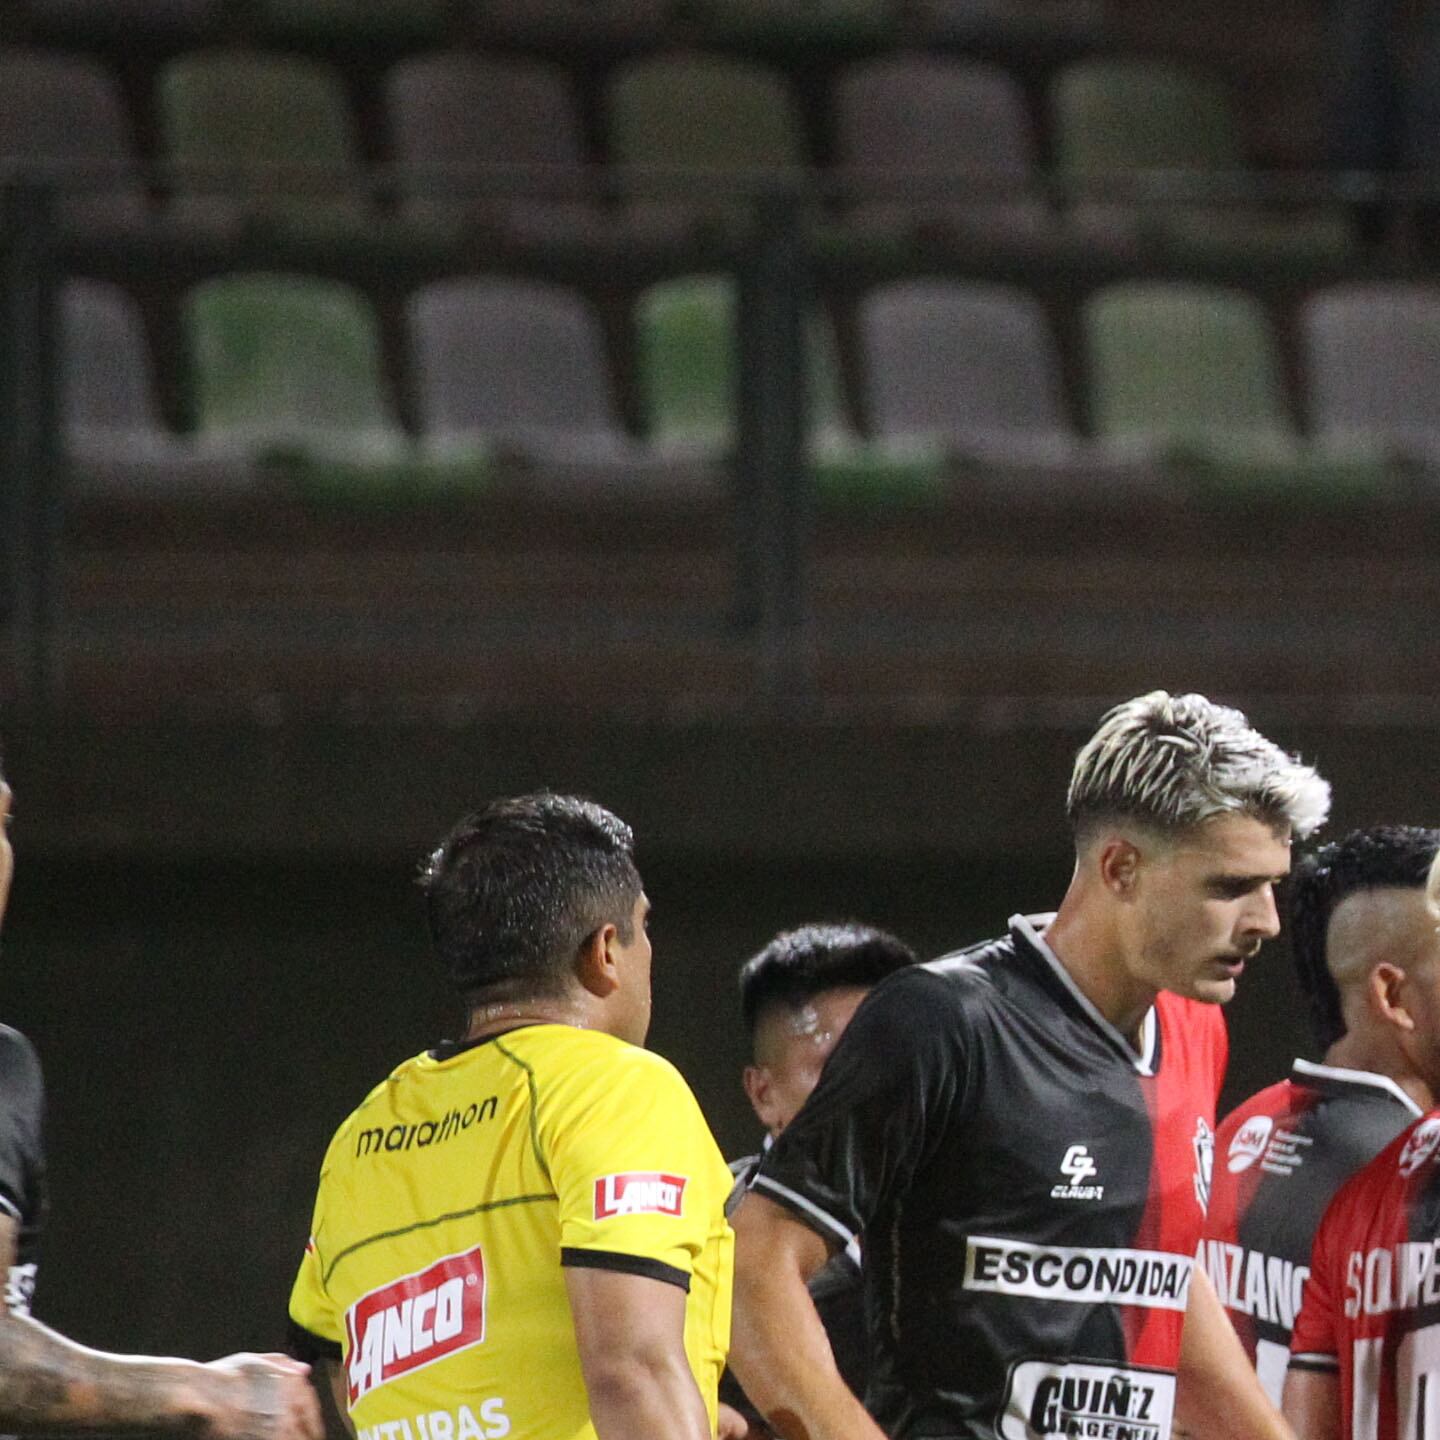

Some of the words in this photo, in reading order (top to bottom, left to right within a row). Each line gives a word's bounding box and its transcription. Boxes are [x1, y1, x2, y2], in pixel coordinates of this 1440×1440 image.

[356, 1095, 498, 1158] marathon
[605, 1175, 679, 1213] LANCO
[349, 1276, 465, 1399] LANCO
